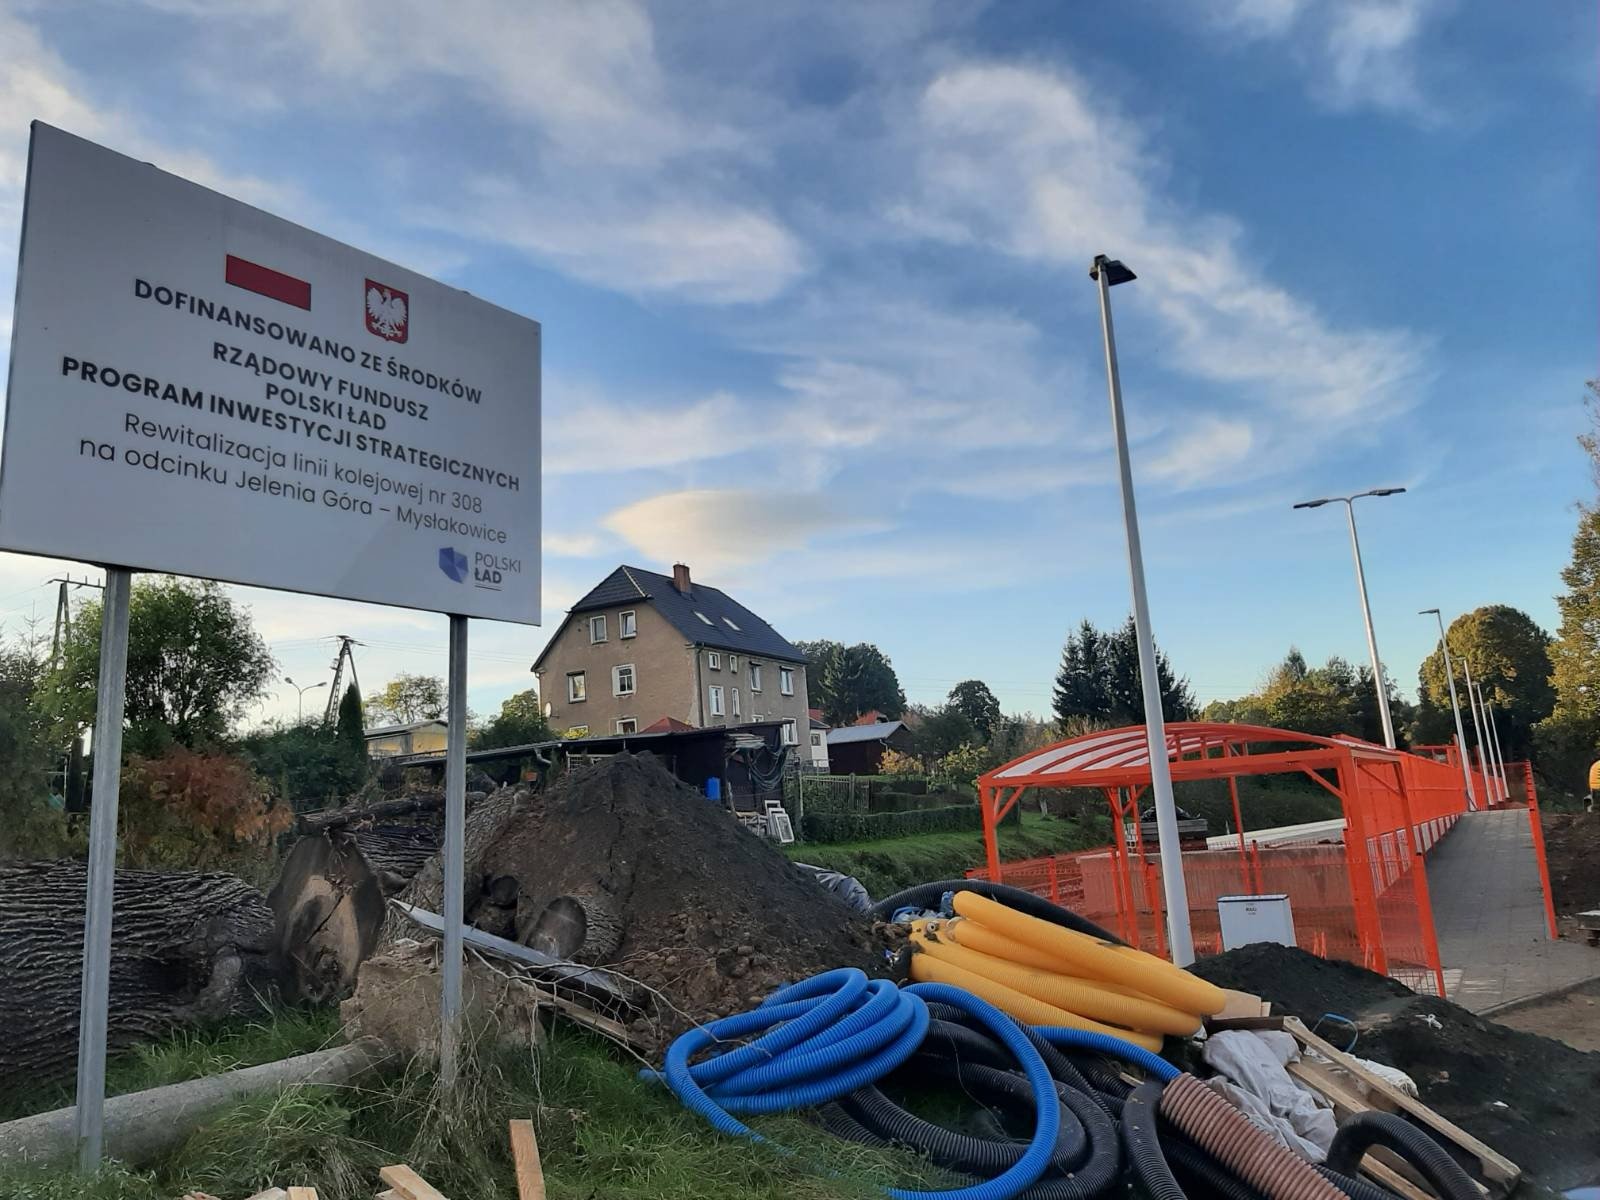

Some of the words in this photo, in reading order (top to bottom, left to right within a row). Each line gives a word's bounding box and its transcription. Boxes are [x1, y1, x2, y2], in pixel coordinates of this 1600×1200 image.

[135, 278, 355, 363] DOFINANSOWANO
[360, 351, 382, 372] ZE
[387, 356, 482, 404] ŚRODKÓW
[213, 341, 333, 391] RZĄDOWY
[338, 379, 429, 421] FUNDUSZ
[62, 356, 203, 410] PROGRAM
[210, 394, 351, 448] INWESTYCJI
[356, 434, 519, 491] STRATEGICZNYCH
[266, 382, 342, 420] POLSKI
[347, 406, 386, 430] ŁAD
[80, 439, 115, 462] na
[125, 450, 227, 485] odcinku
[235, 471, 315, 503] Jelenia
[322, 489, 372, 515] Góra
[397, 505, 507, 543] Mysłakowice
[125, 412, 286, 470] Rewitalizacja
[294, 452, 328, 477] linii
[335, 462, 423, 505] kolejowej
[429, 488, 446, 504] nr
[451, 492, 482, 513] 308
[474, 567, 502, 584] ŁAD
[475, 552, 521, 573] POLSKI
